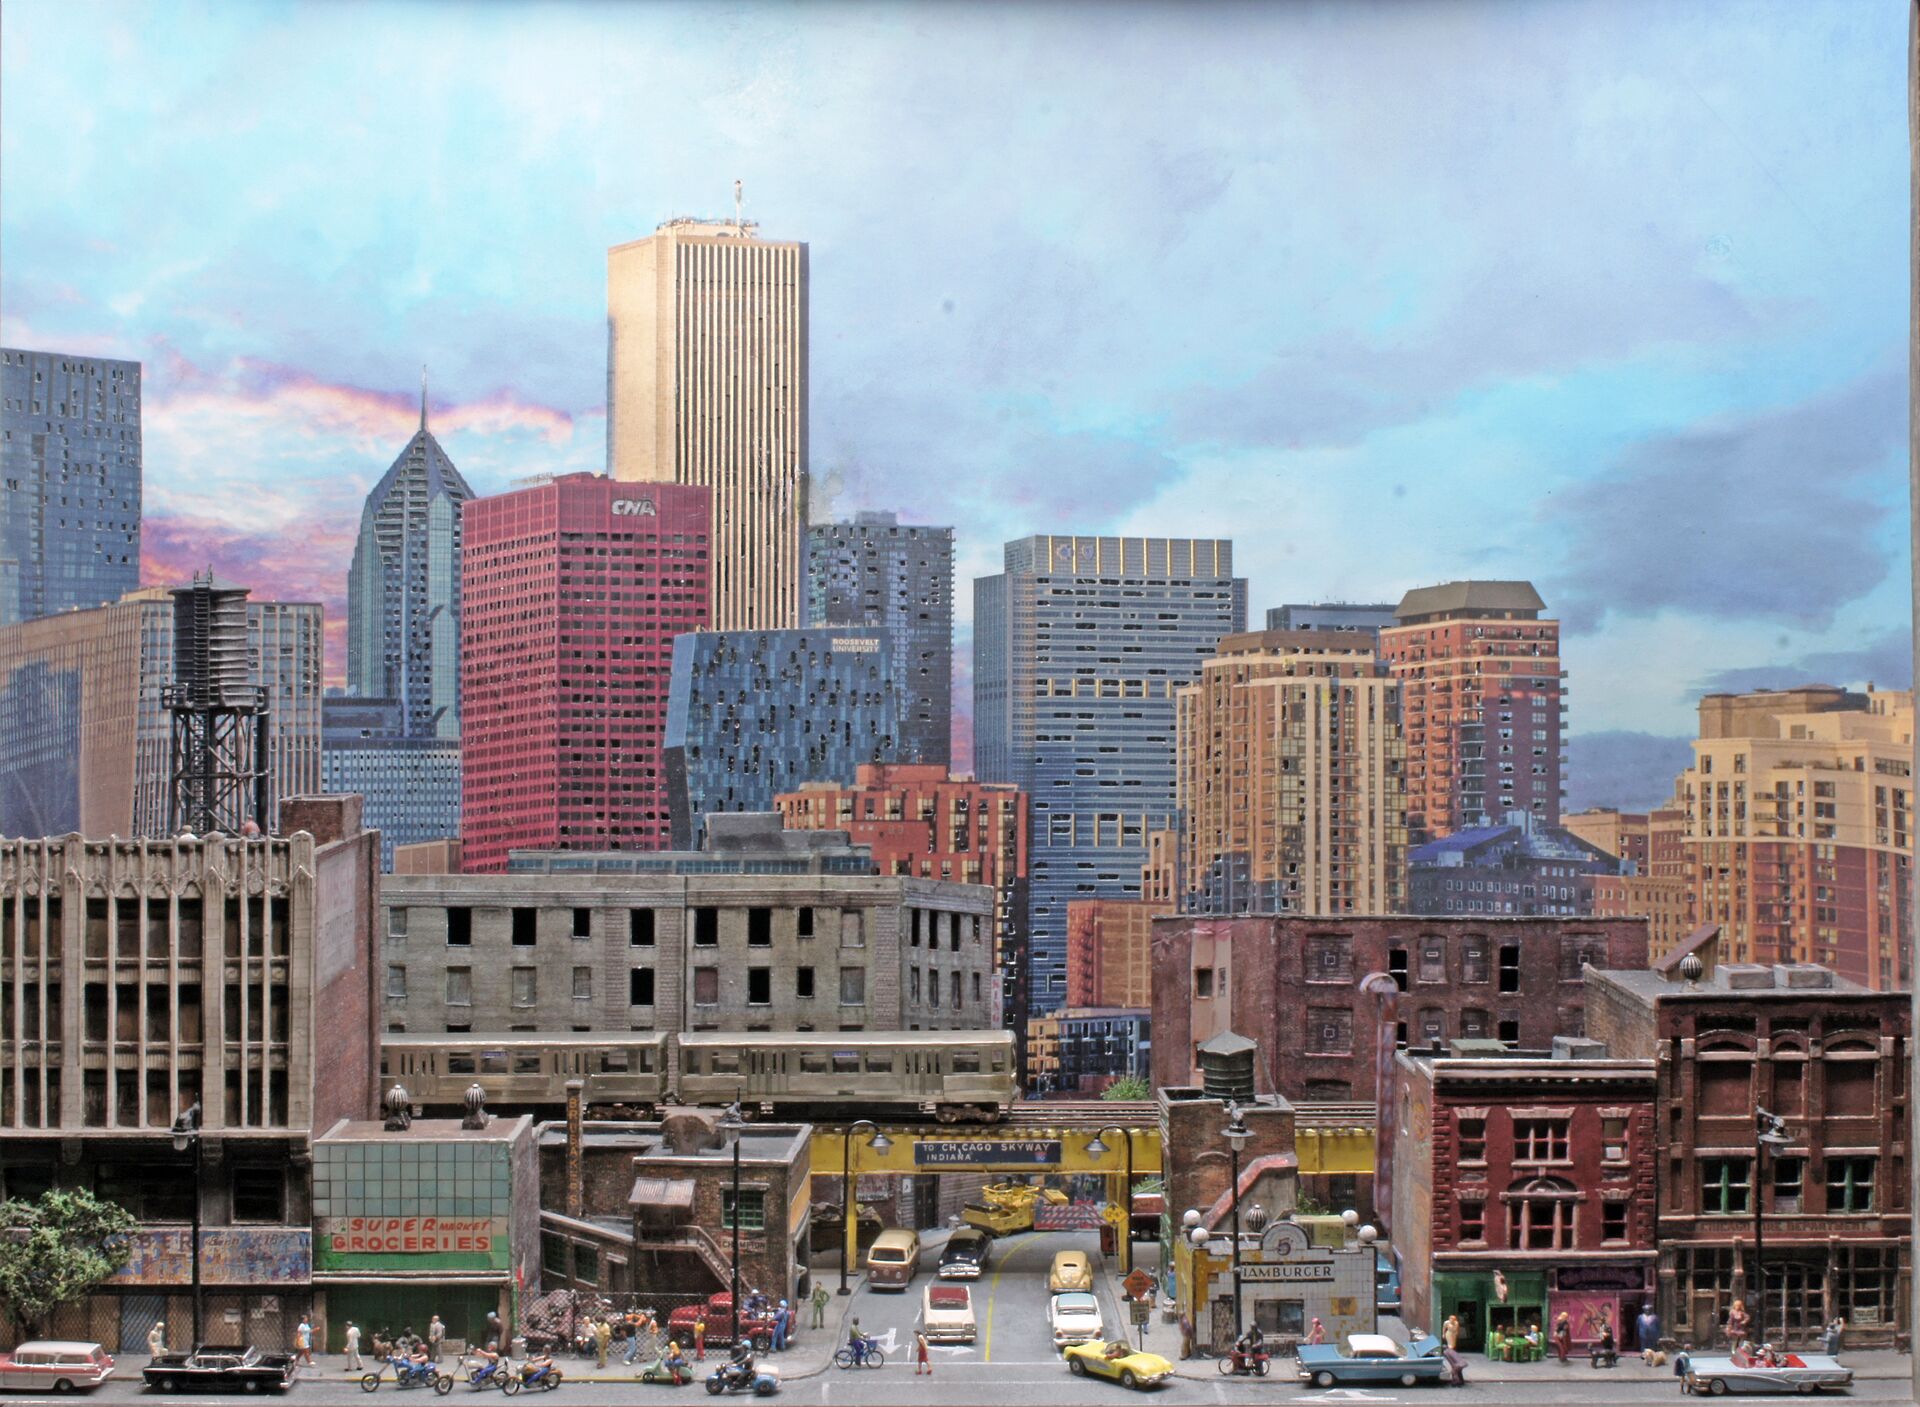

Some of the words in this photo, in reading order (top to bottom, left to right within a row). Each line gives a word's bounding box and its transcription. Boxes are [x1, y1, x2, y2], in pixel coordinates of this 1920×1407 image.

[611, 499, 656, 516] CNA
[832, 645, 879, 653] UNIVERSITY
[923, 1144, 934, 1152] TO
[1001, 1143, 1050, 1152] SKYWAY
[926, 1153, 972, 1161] INDIANA
[351, 1217, 437, 1232] SUPER
[438, 1220, 490, 1232] MARKET
[332, 1236, 490, 1251] GROCERIES
